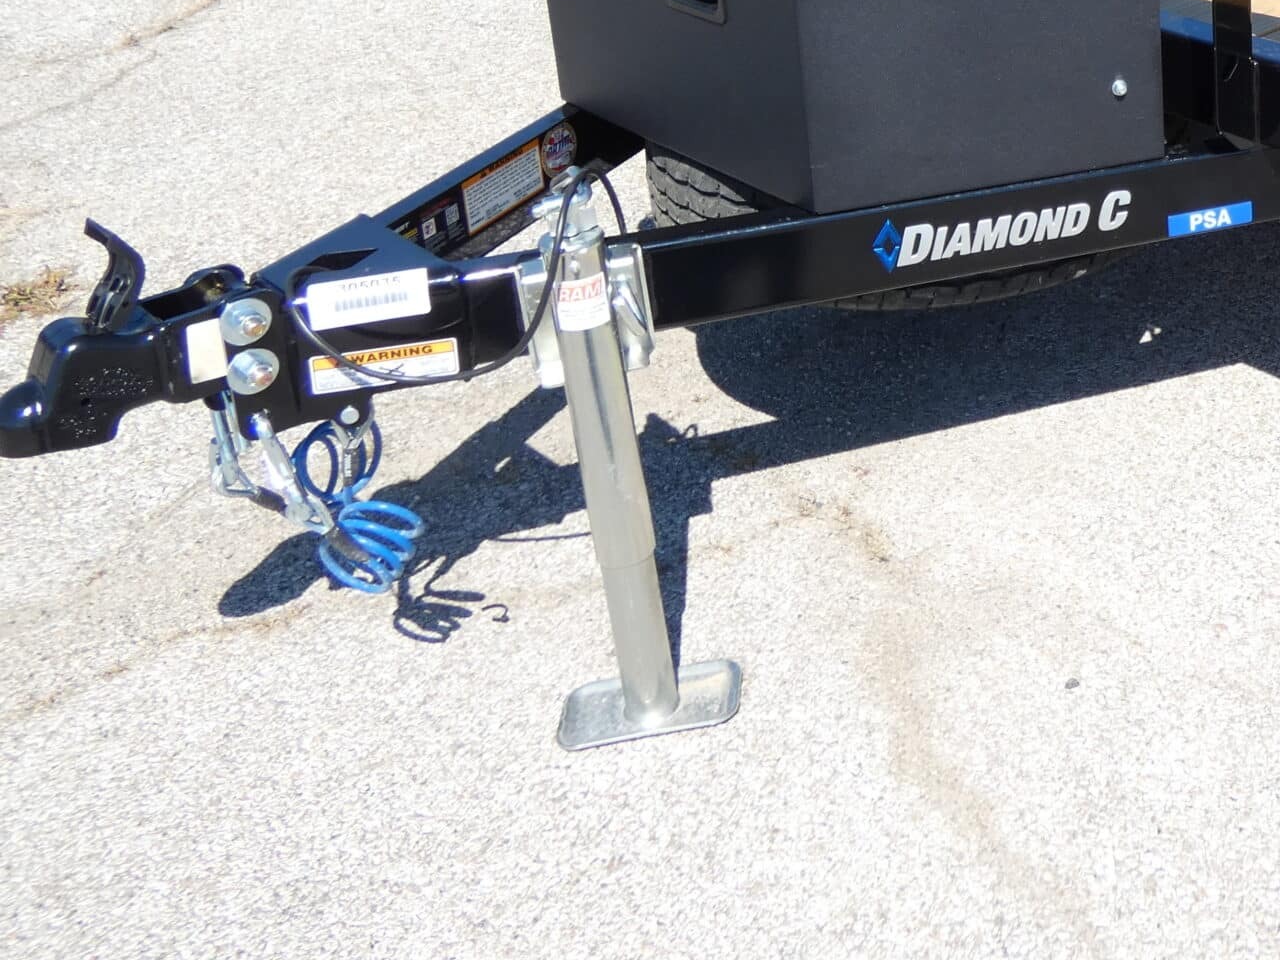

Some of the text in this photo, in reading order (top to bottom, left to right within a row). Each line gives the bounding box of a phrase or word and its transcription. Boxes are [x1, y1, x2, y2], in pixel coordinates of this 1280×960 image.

[896, 190, 1132, 268] DIAMOND C
[1189, 208, 1232, 232] PSA
[351, 345, 433, 364] WARNING
